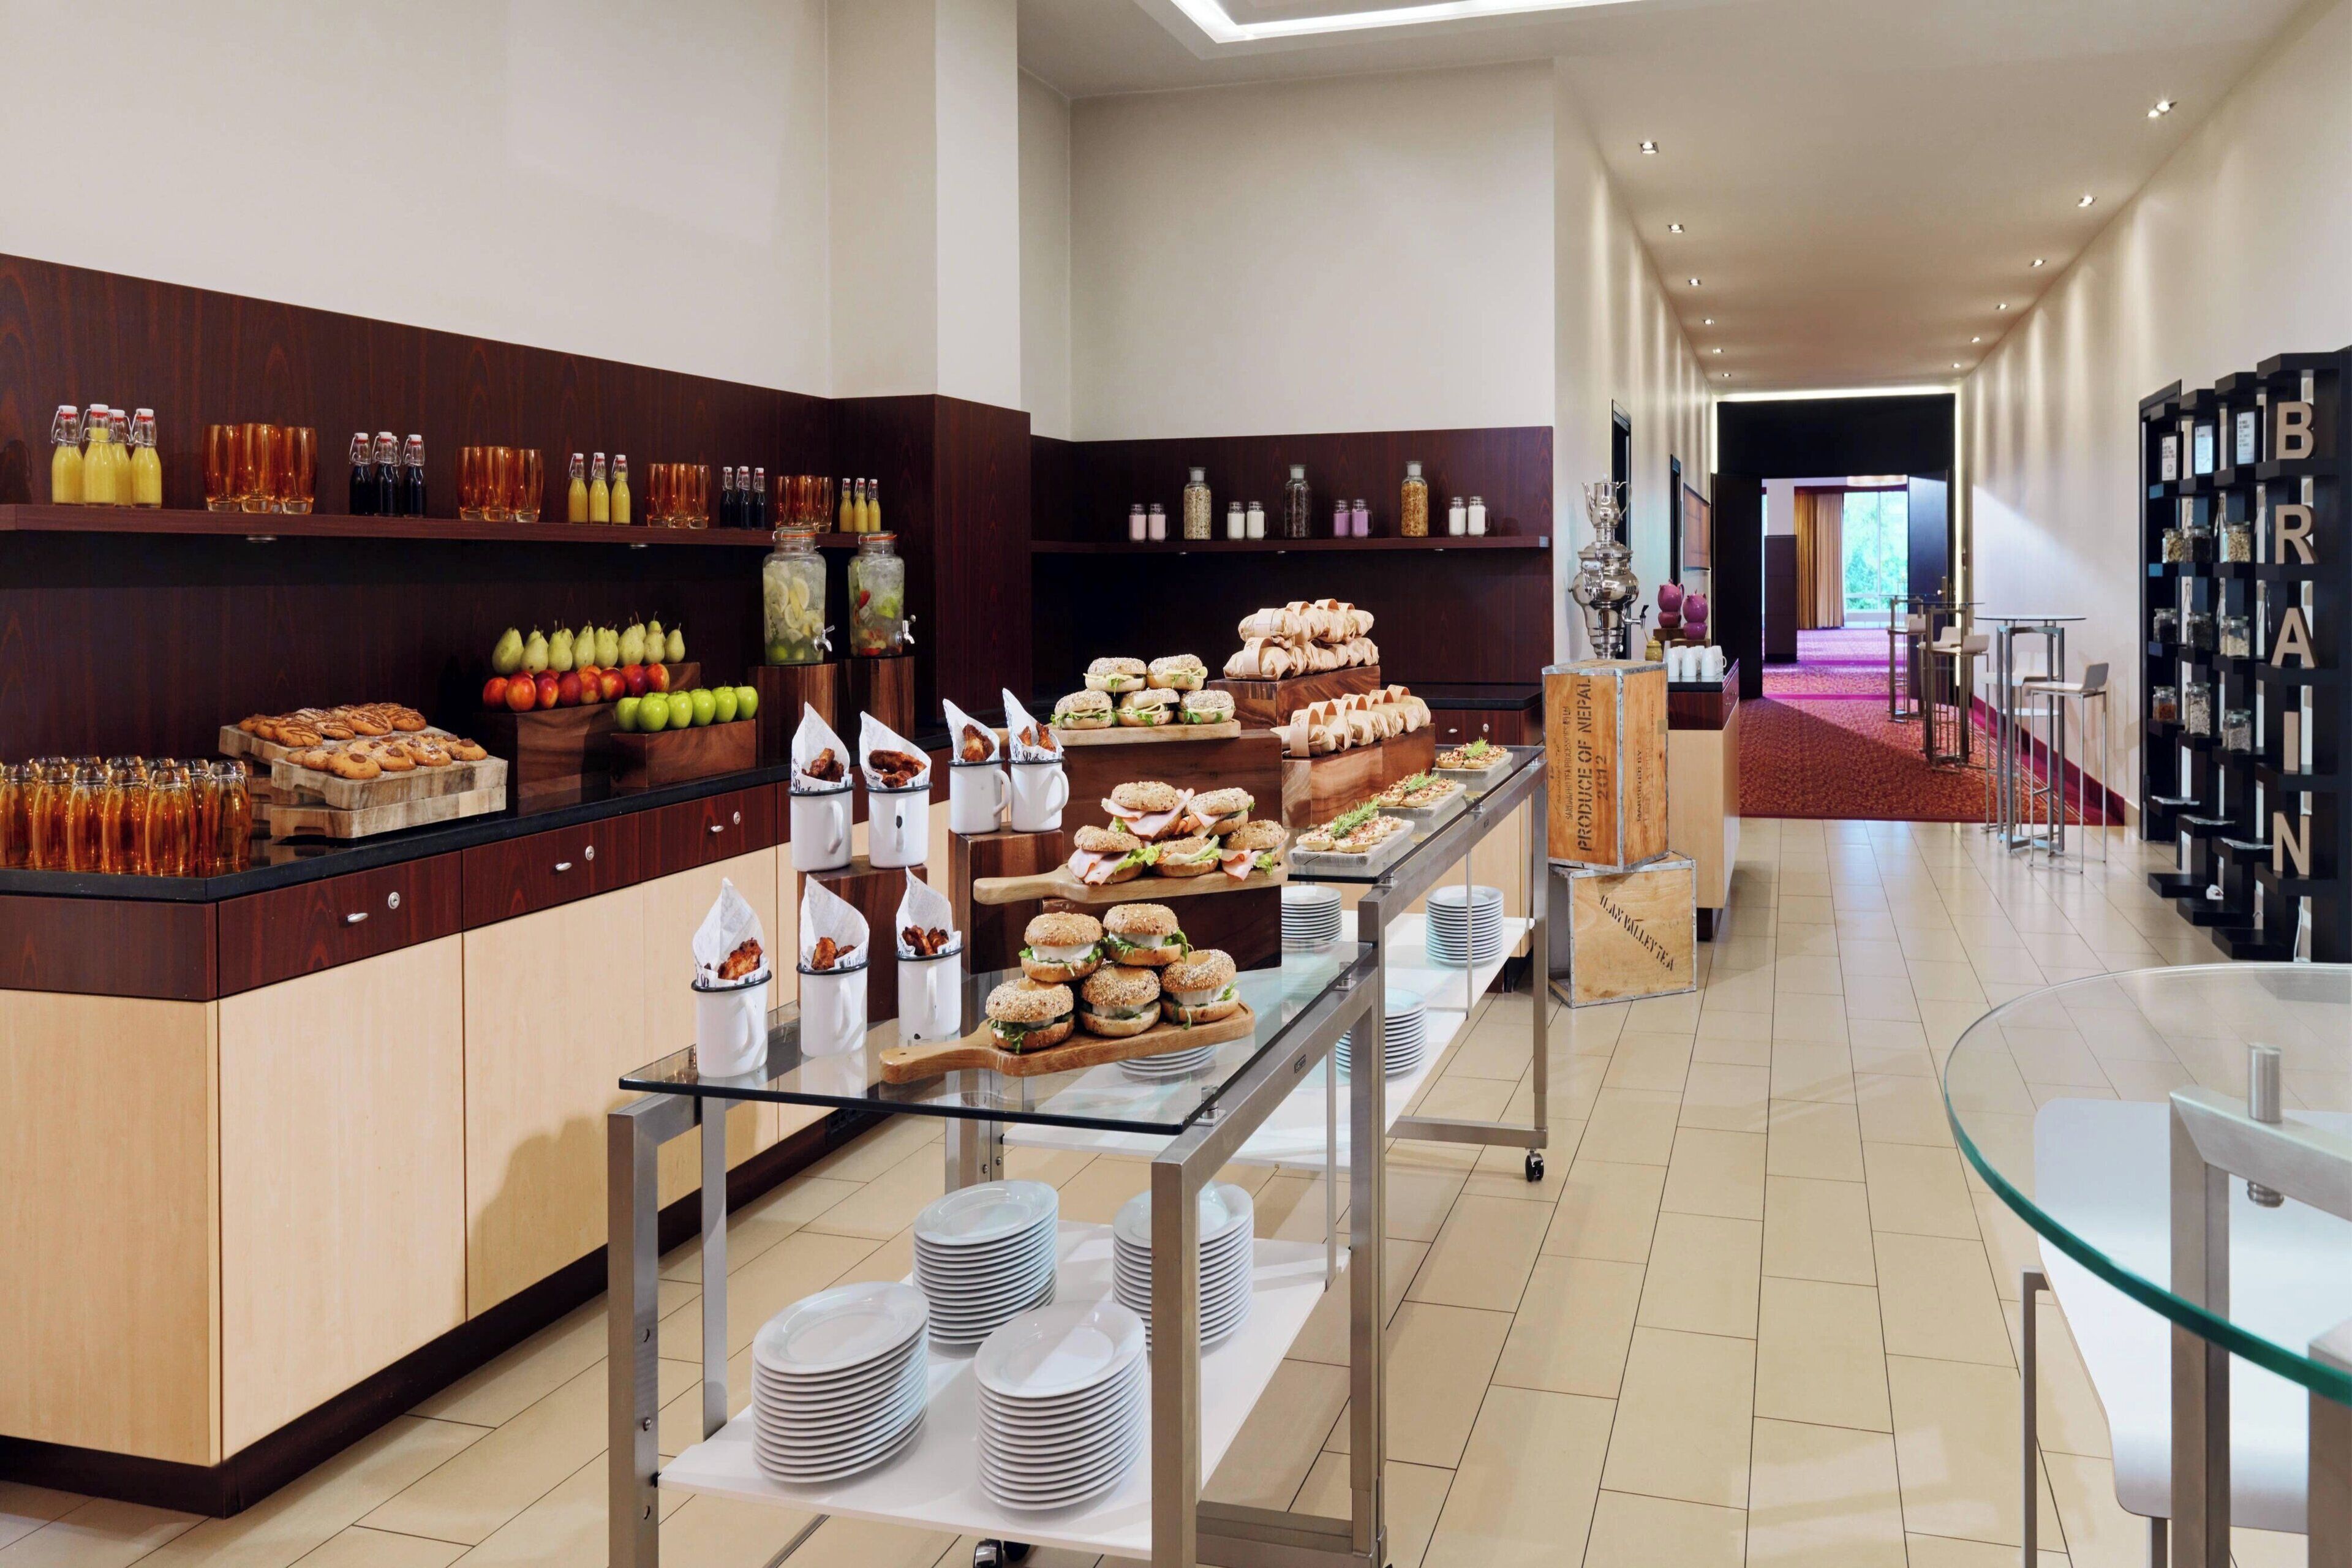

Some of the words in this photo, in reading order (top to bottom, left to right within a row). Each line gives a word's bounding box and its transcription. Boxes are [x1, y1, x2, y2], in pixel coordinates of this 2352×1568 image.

[2271, 401, 2318, 876] BRAIN
[1577, 678, 1593, 734] NEPAL
[1577, 739, 1593, 764] OF
[1596, 755, 1609, 801] 2012
[1577, 767, 1593, 851] PRODUCE
[1624, 914, 1657, 952] VALLEY
[1656, 945, 1674, 971] TEA
